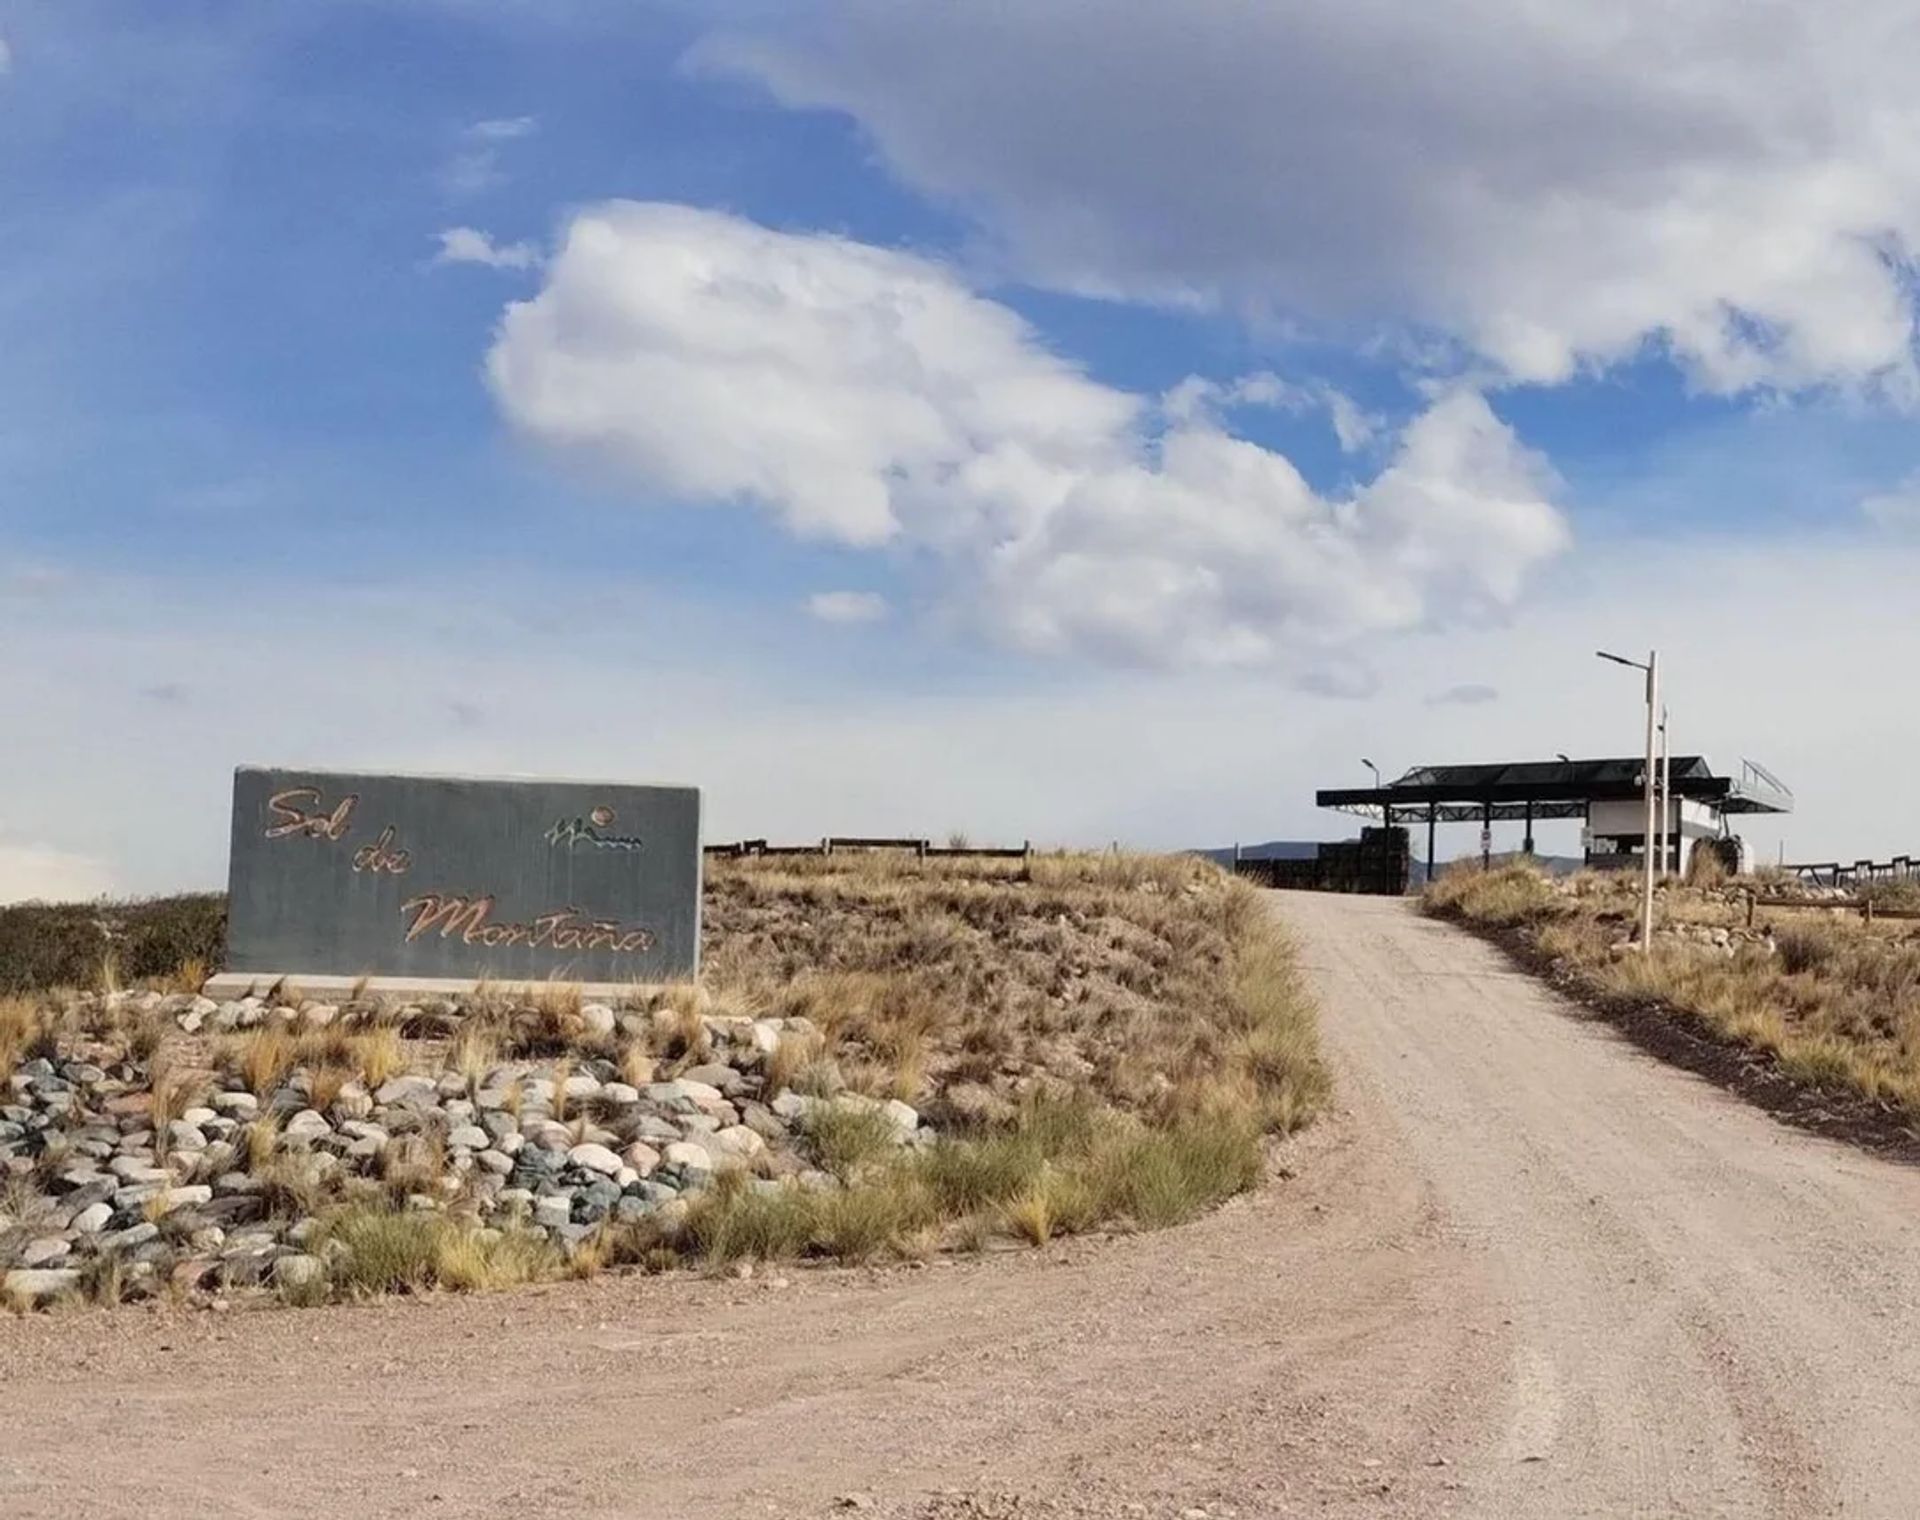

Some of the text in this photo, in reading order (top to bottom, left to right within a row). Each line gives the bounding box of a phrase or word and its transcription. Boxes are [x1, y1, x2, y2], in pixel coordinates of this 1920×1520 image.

[265, 786, 360, 841] Sol
[352, 825, 412, 874] de
[400, 893, 658, 951] Montaña
